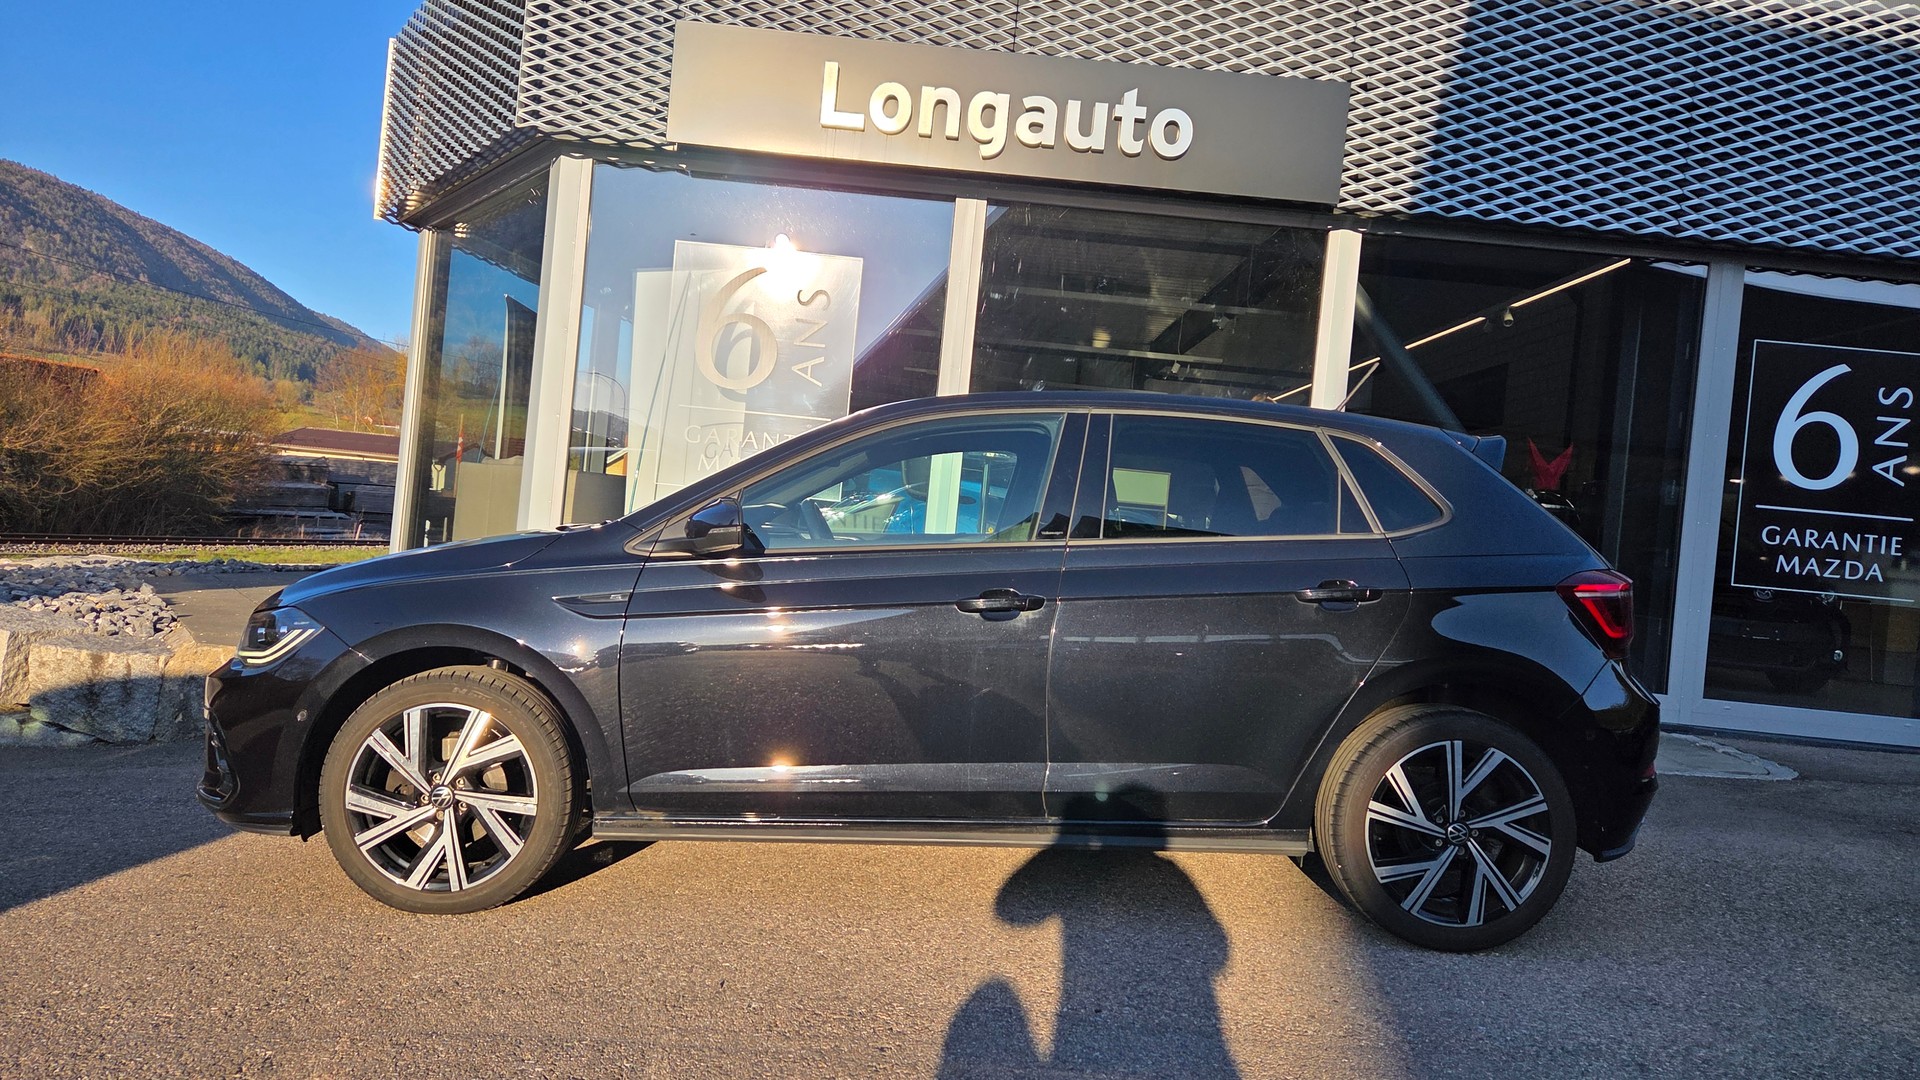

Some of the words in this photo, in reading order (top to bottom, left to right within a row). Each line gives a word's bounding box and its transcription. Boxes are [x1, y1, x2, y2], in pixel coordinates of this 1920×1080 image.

[820, 61, 1194, 160] Longauto
[695, 267, 778, 390] 6
[791, 289, 831, 387] ANS
[1773, 363, 1859, 491] 6
[1871, 386, 1914, 487] ANS
[1761, 525, 1903, 556] GARANTIE
[1775, 554, 1884, 583] MAZDA
